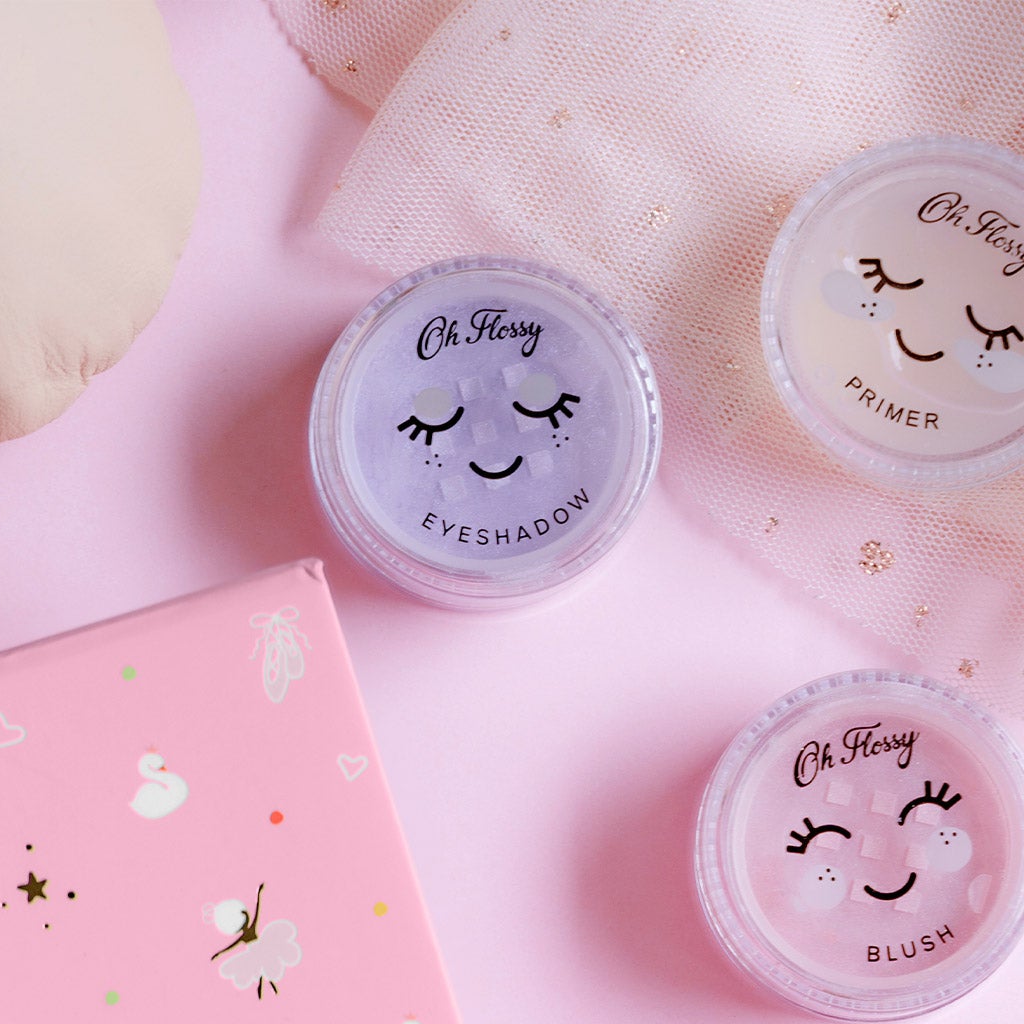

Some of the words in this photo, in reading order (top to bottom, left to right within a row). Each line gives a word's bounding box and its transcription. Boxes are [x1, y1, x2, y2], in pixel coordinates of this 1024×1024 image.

[917, 191, 969, 228] Oh
[416, 315, 460, 361] Oh
[465, 308, 545, 358] Flossy
[844, 375, 940, 431] PRIMER
[421, 488, 591, 546] EYESHADOW
[793, 740, 835, 788] Oh
[840, 721, 921, 770] Flossy
[867, 924, 955, 963] BLUSH
